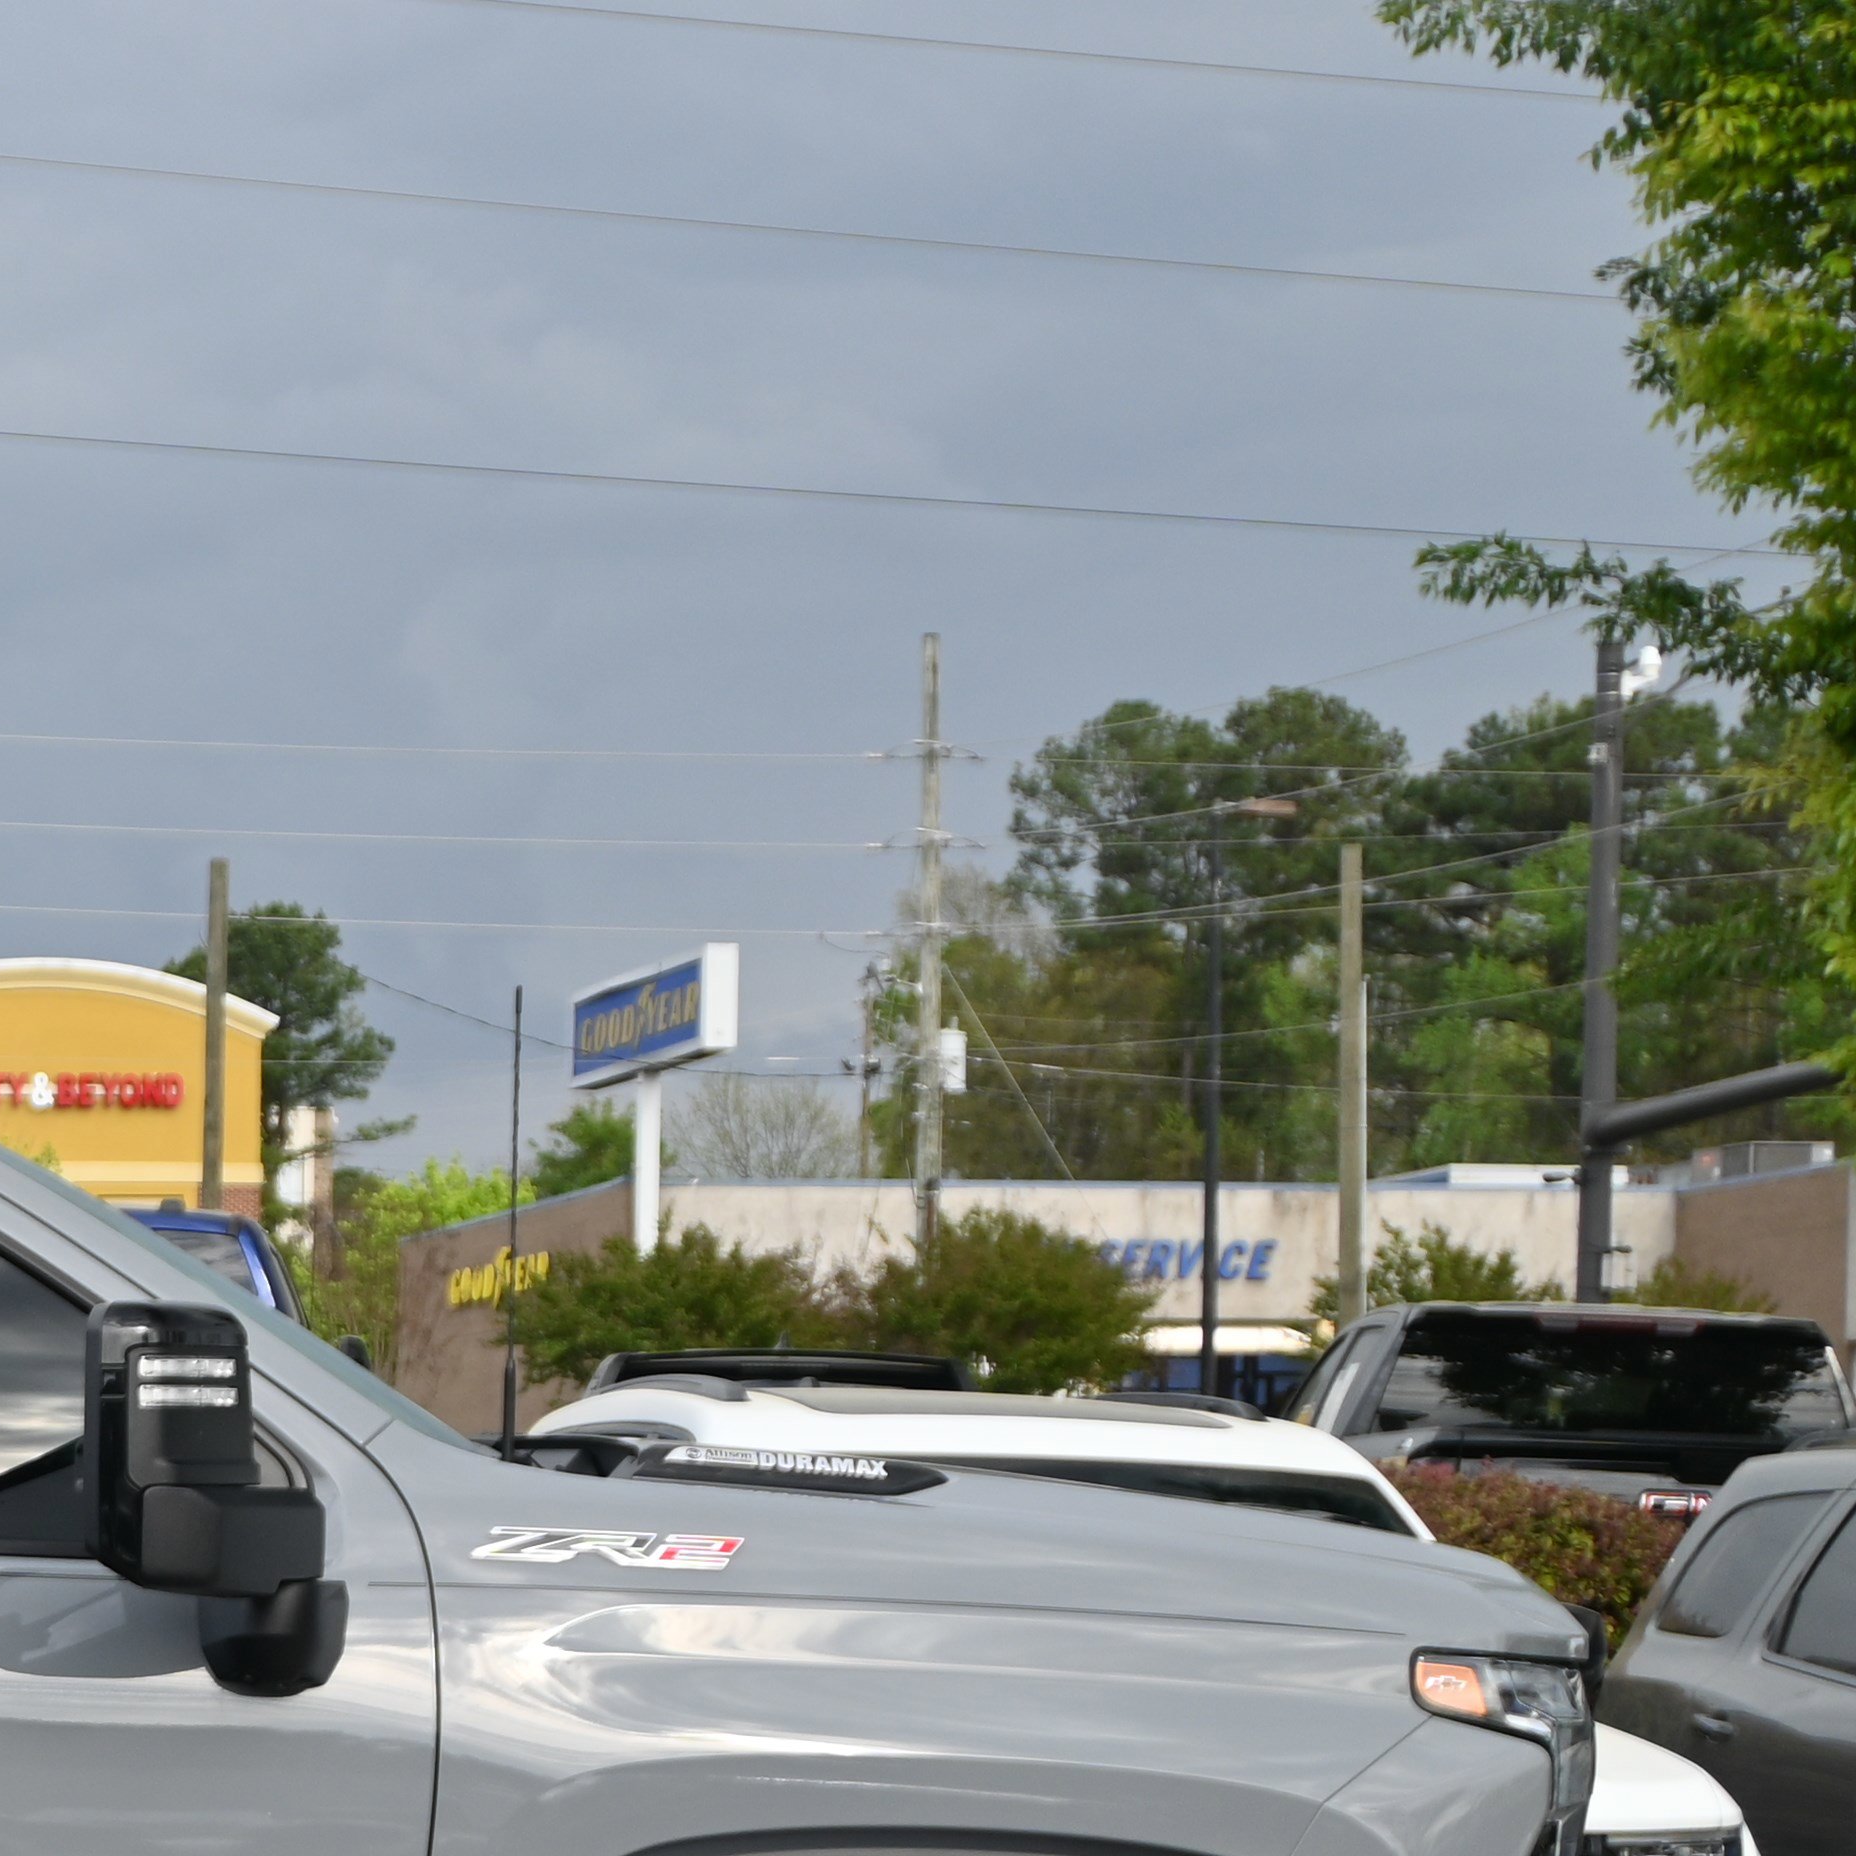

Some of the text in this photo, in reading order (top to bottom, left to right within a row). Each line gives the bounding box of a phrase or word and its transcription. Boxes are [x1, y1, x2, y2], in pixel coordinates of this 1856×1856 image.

[57, 1071, 184, 1107] BEYOND
[1100, 1238, 1278, 1281] SERVCE
[759, 1451, 888, 1479] DURAMAX
[469, 1525, 745, 1571] ZR2
